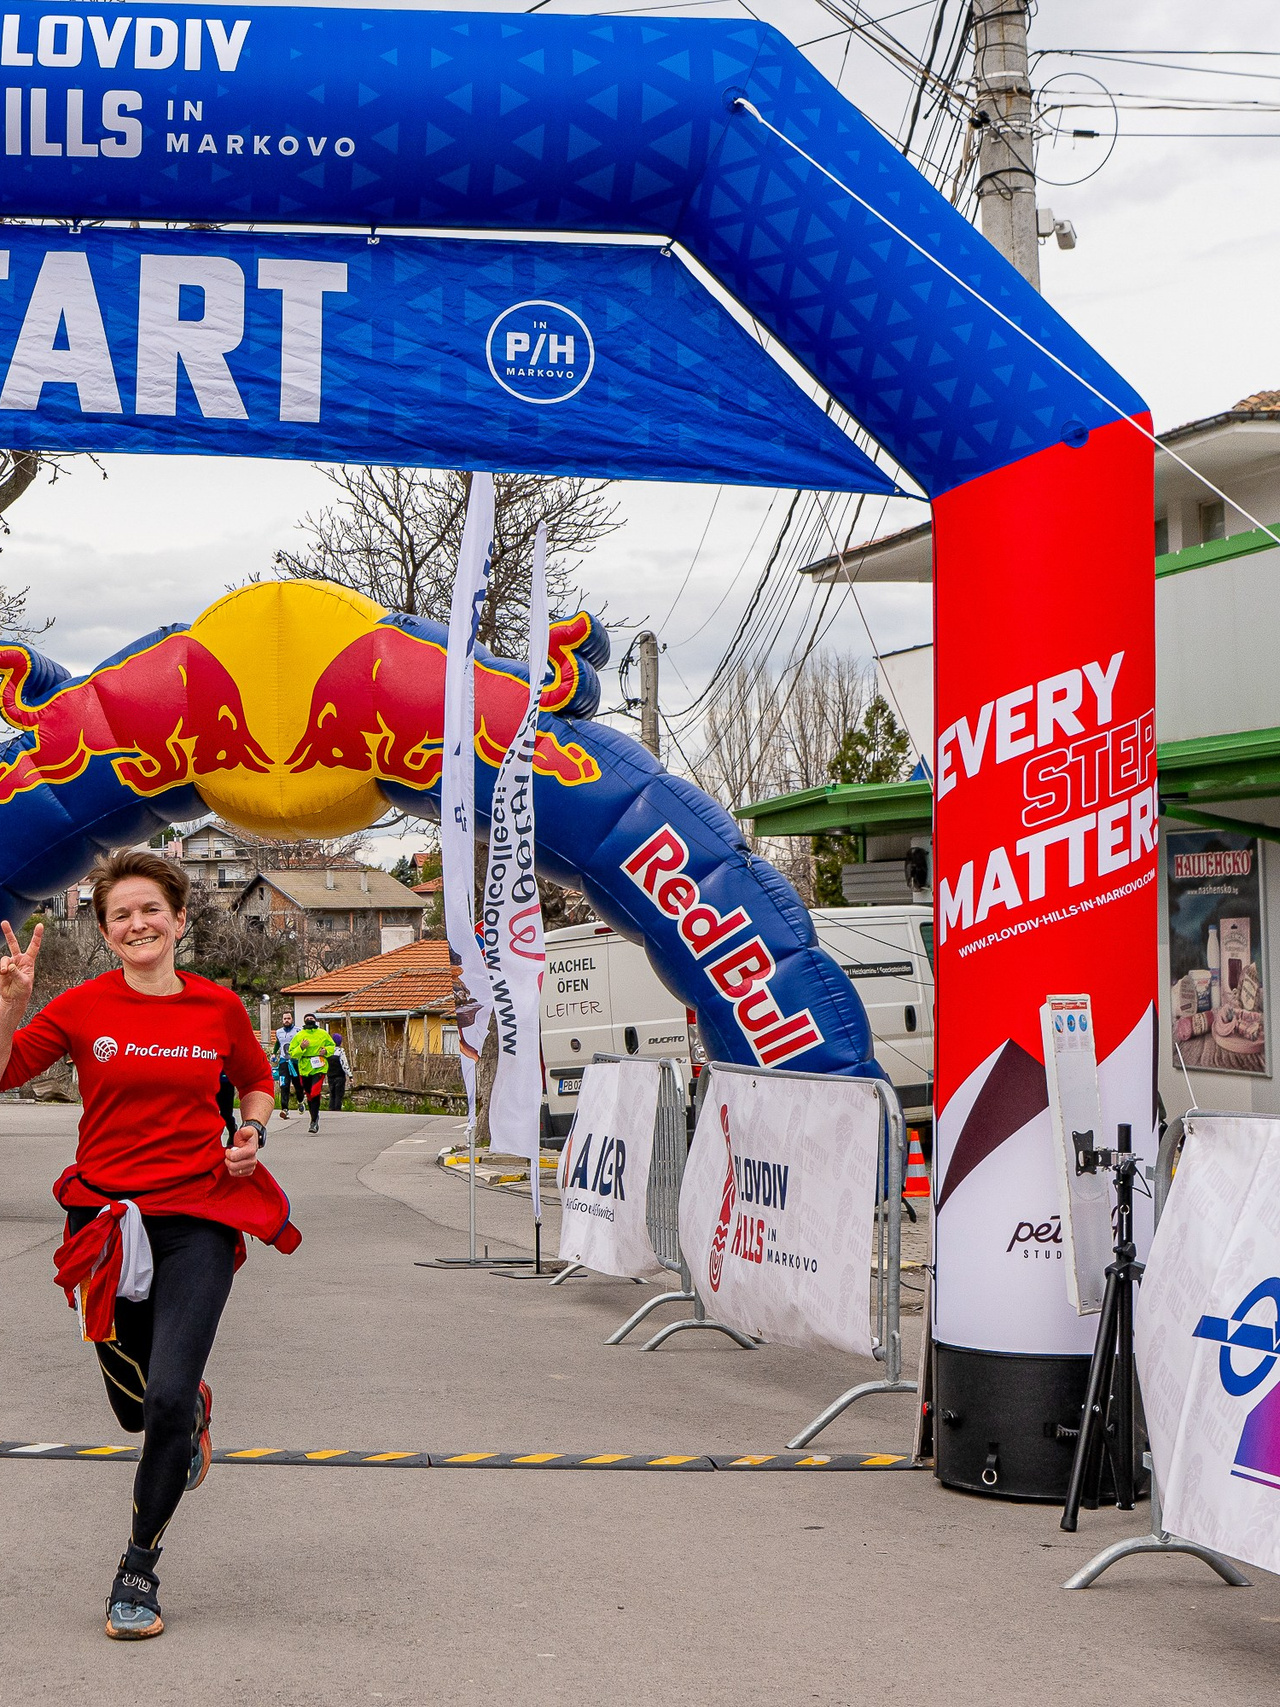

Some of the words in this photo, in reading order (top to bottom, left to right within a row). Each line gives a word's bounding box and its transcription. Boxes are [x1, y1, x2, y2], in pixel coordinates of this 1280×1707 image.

[166, 100, 204, 122] IN
[165, 133, 357, 157] MARKOVO
[533, 320, 548, 329] IN
[506, 331, 575, 366] P/H
[505, 367, 575, 379] MARKOVO
[937, 650, 1126, 802] EVERY
[1021, 707, 1156, 828] STEP
[1173, 850, 1252, 878] НАШЕНСКО
[958, 867, 1156, 959] WWW.PLOVDIV-HILLS-IN-MARKOVO.COM
[622, 825, 750, 957] Red
[706, 937, 822, 1067] Bull
[549, 957, 596, 974] KACHEL
[557, 977, 589, 994] ÖFEN
[546, 1001, 603, 1018] LEITER
[124, 1043, 189, 1058] ProCredit
[191, 1045, 218, 1060] Bank
[648, 1035, 685, 1045] DUCATO
[734, 1155, 789, 1211] PLOVDIV
[767, 1227, 777, 1243] IN
[766, 1249, 818, 1274] MARKOVO
